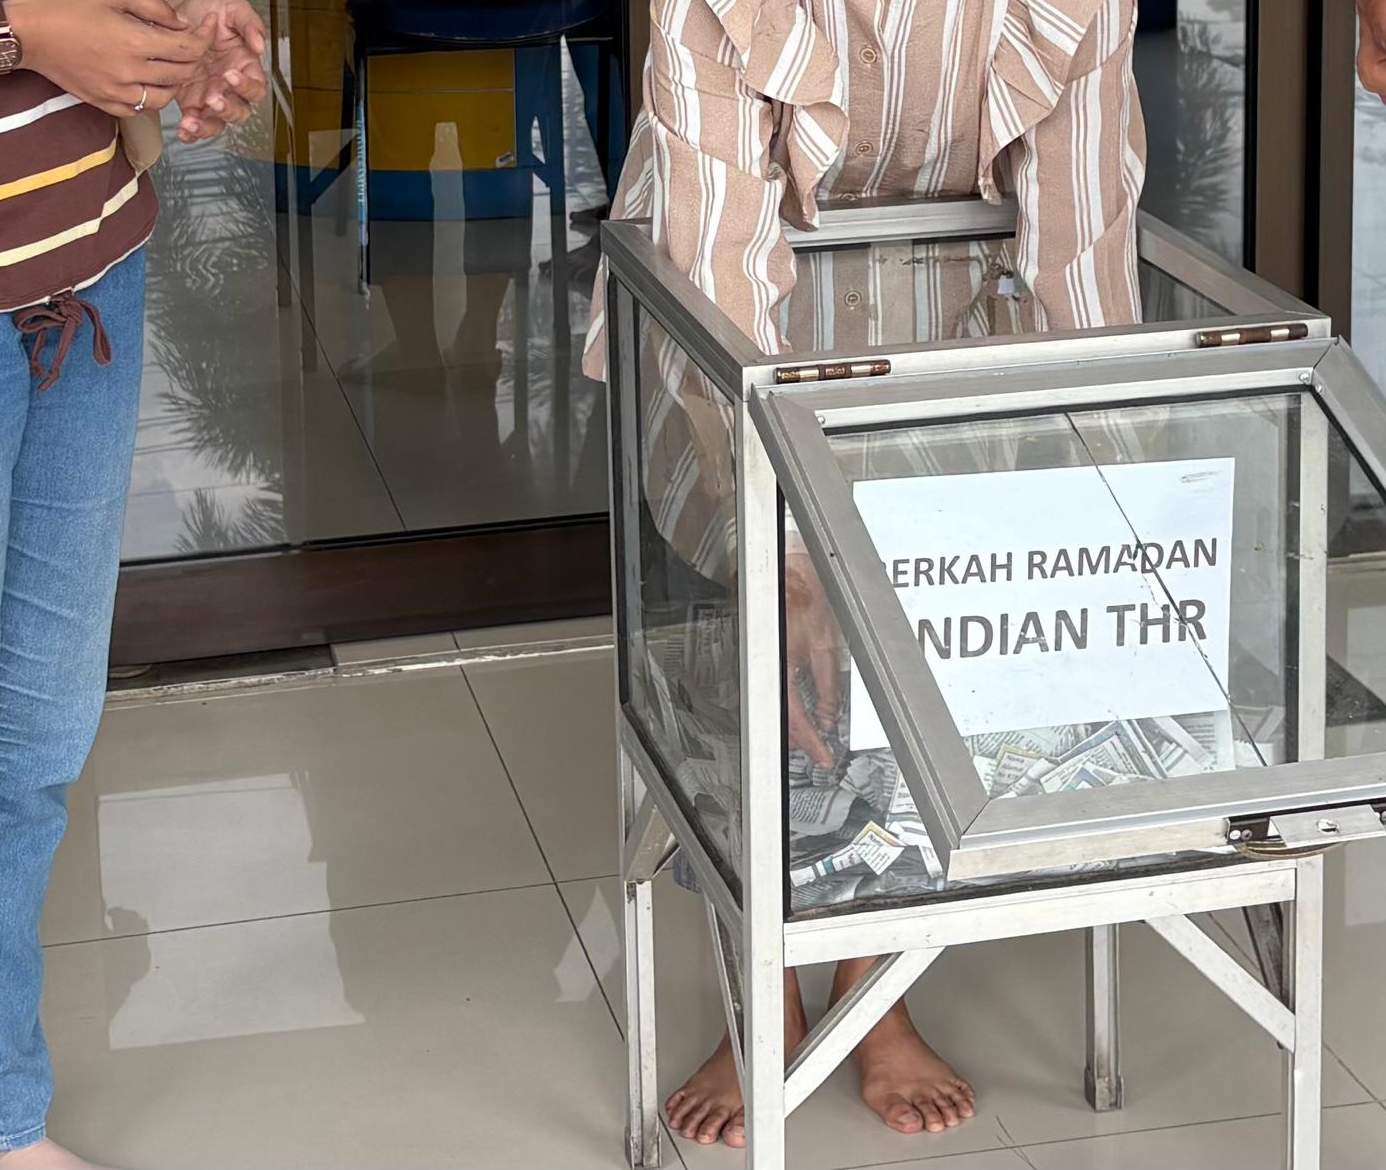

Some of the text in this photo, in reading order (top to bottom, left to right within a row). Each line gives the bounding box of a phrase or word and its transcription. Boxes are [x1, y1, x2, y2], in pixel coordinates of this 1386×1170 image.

[882, 537, 1218, 588] ERKAH RAMADAN
[917, 598, 1207, 661] NDIAN THR
